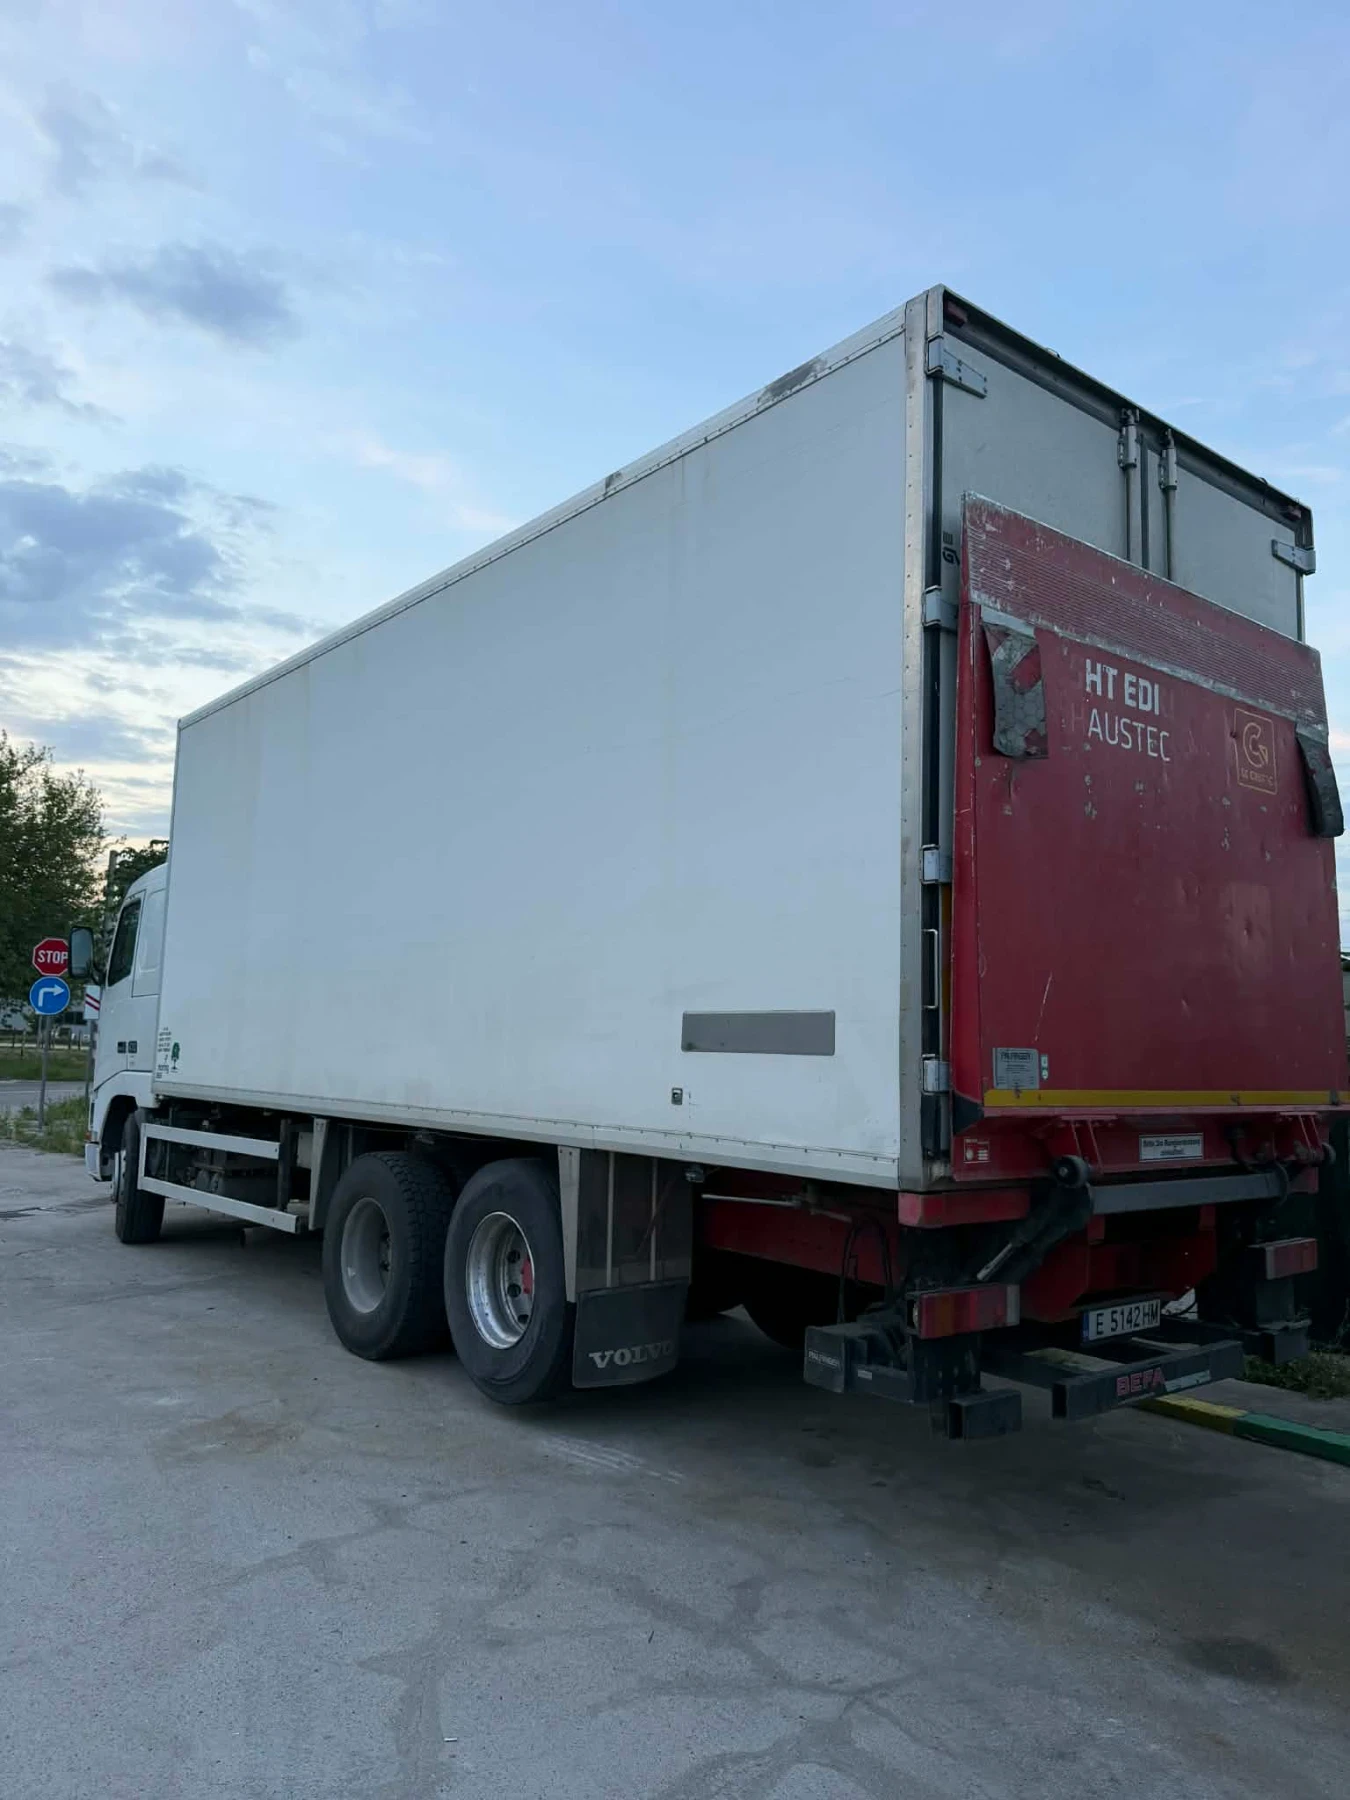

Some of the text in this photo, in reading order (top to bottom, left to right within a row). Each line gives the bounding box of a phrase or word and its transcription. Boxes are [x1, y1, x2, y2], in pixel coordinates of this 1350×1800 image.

[1124, 672, 1160, 716] EDI
[1088, 708, 1171, 762] AUSTEC
[37, 949, 69, 964] STOP
[1096, 1312, 1105, 1336] E
[588, 1340, 676, 1369] VOLVO
